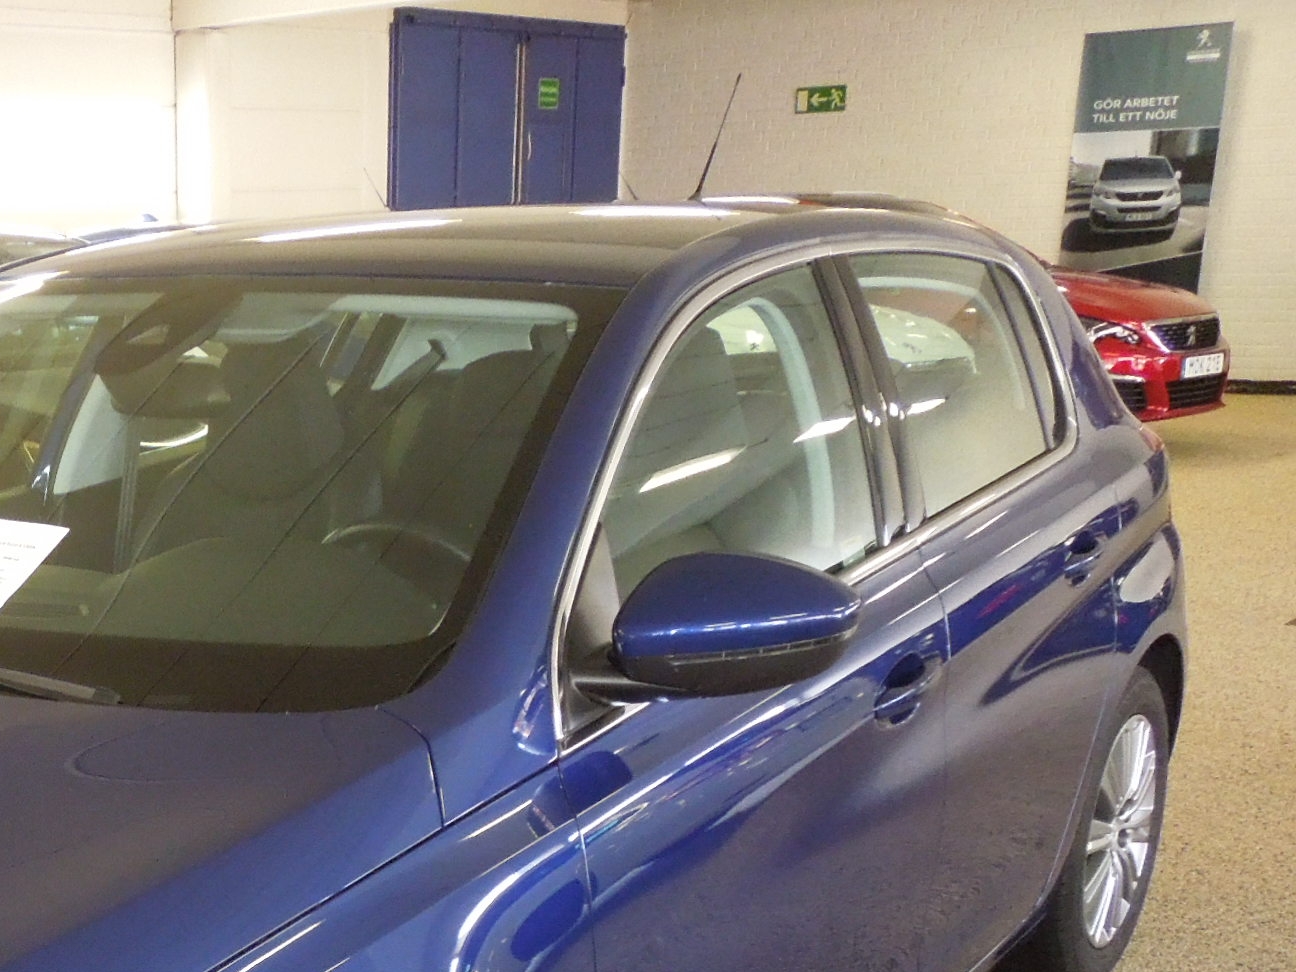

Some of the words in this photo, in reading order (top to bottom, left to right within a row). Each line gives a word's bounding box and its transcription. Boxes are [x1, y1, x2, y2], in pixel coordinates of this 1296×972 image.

[1093, 97, 1121, 110] GÖR
[1123, 95, 1179, 108] ARBETET
[1092, 112, 1116, 123] TILL
[1119, 111, 1143, 122] ETT
[1145, 108, 1177, 120] NÖJE
